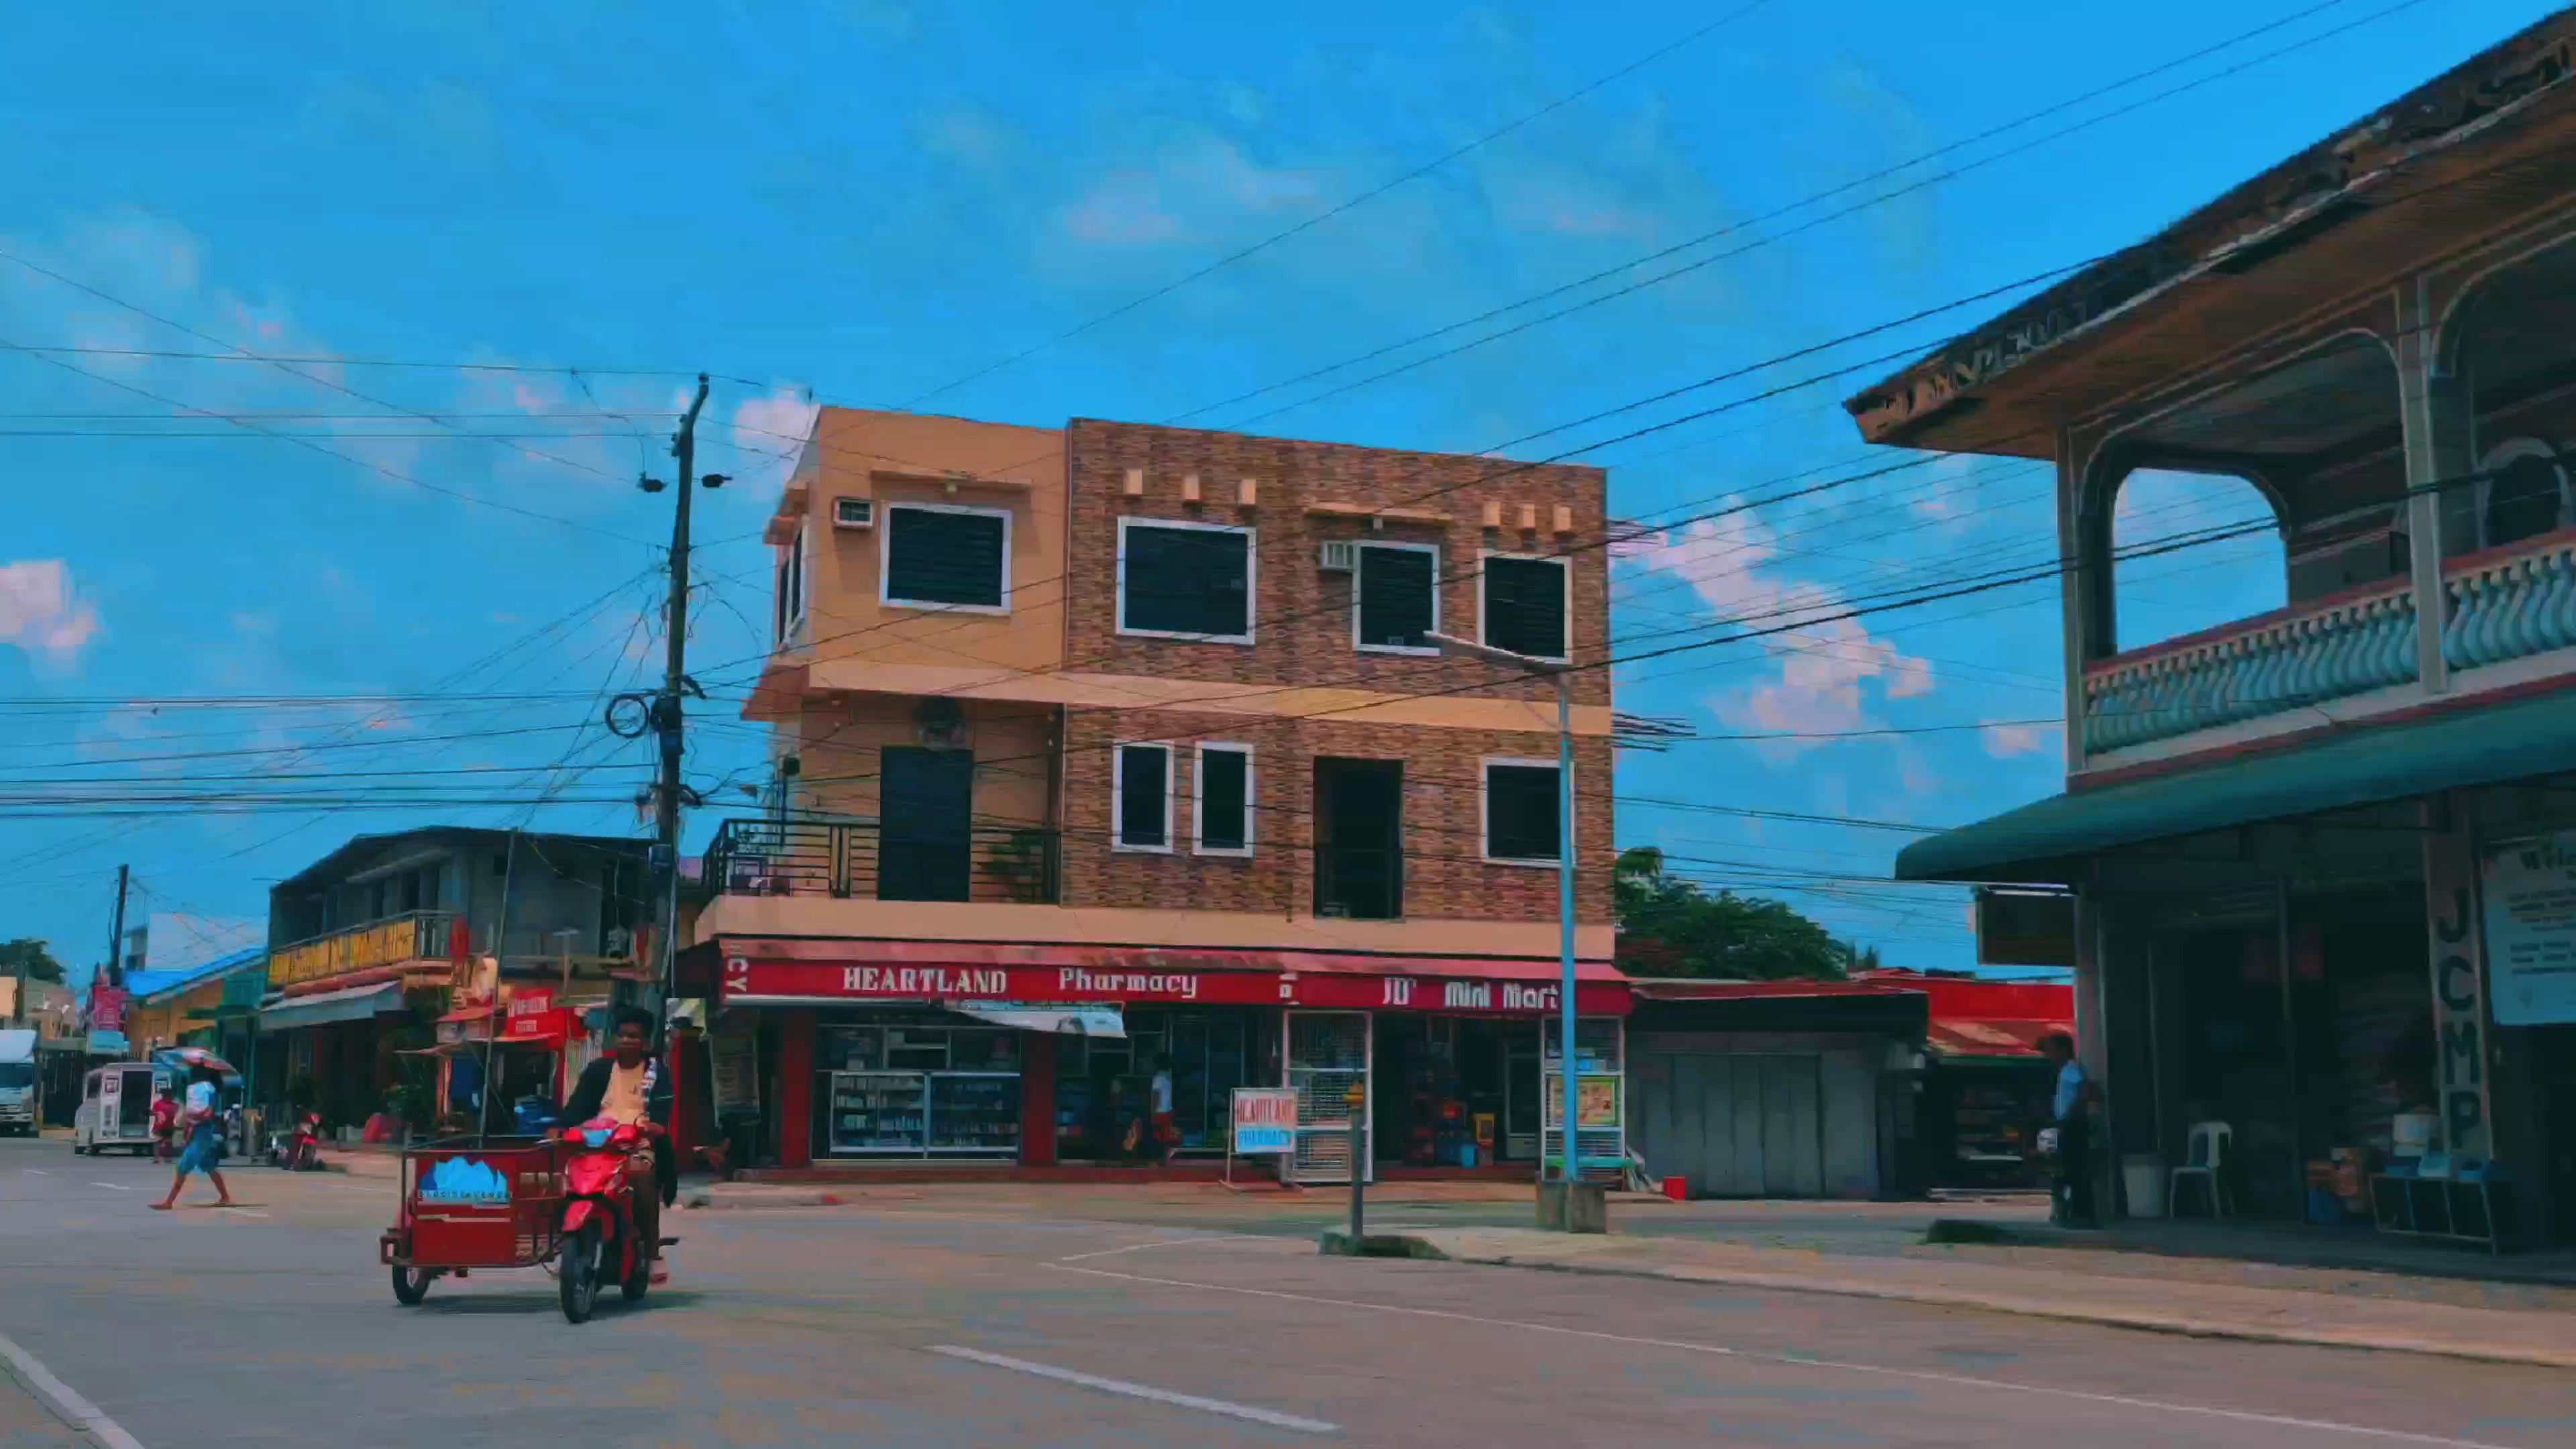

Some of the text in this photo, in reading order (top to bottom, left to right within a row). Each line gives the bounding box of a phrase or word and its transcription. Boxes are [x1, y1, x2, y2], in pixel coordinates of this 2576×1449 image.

[842, 965, 1197, 999] HEARTLAND Pharmacy
[1503, 982, 1559, 1009] Mart
